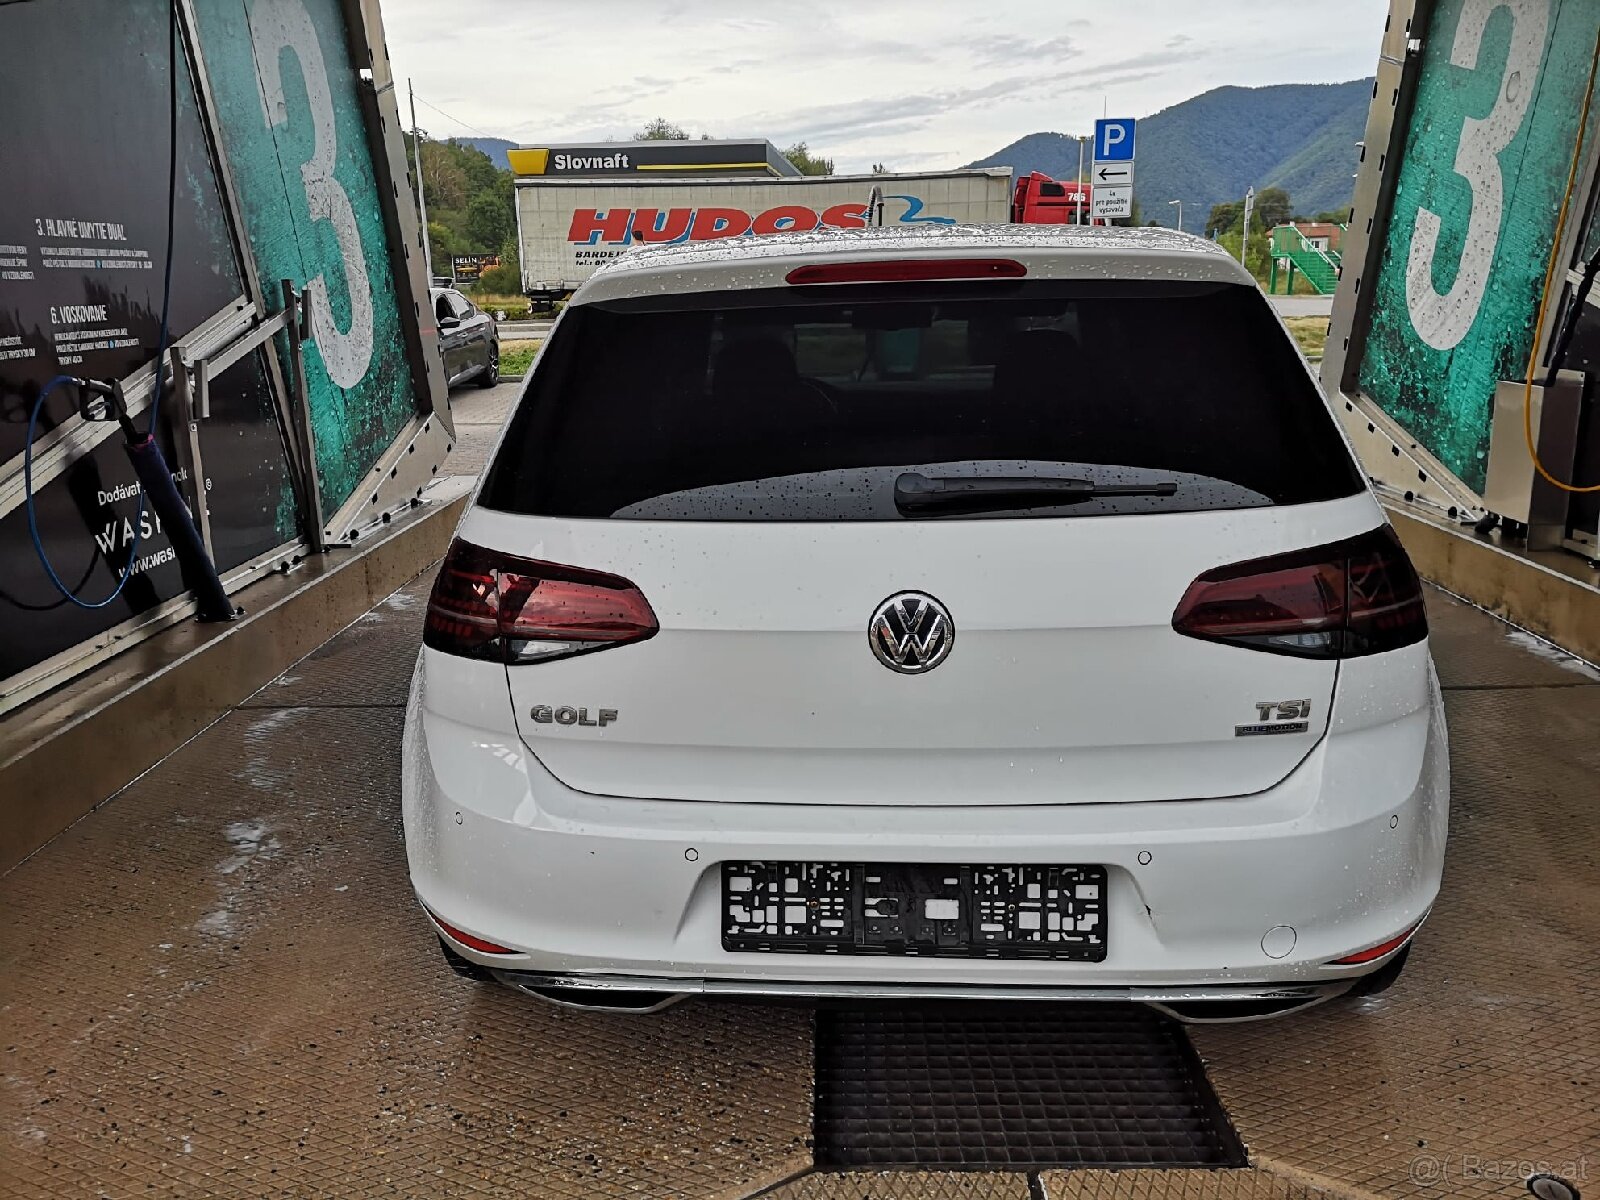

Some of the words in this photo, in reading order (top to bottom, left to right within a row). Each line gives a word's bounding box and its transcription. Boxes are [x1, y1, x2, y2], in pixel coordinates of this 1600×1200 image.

[1103, 123, 1126, 156] P
[554, 153, 630, 171] Slovnaft
[1405, 0, 1551, 351] 3
[251, 0, 373, 389] 3
[35, 218, 46, 236] 3.
[567, 202, 870, 246] HUDOS
[50, 306, 60, 324] 6.
[530, 704, 619, 727] GOLF
[1256, 698, 1311, 721] TSI
